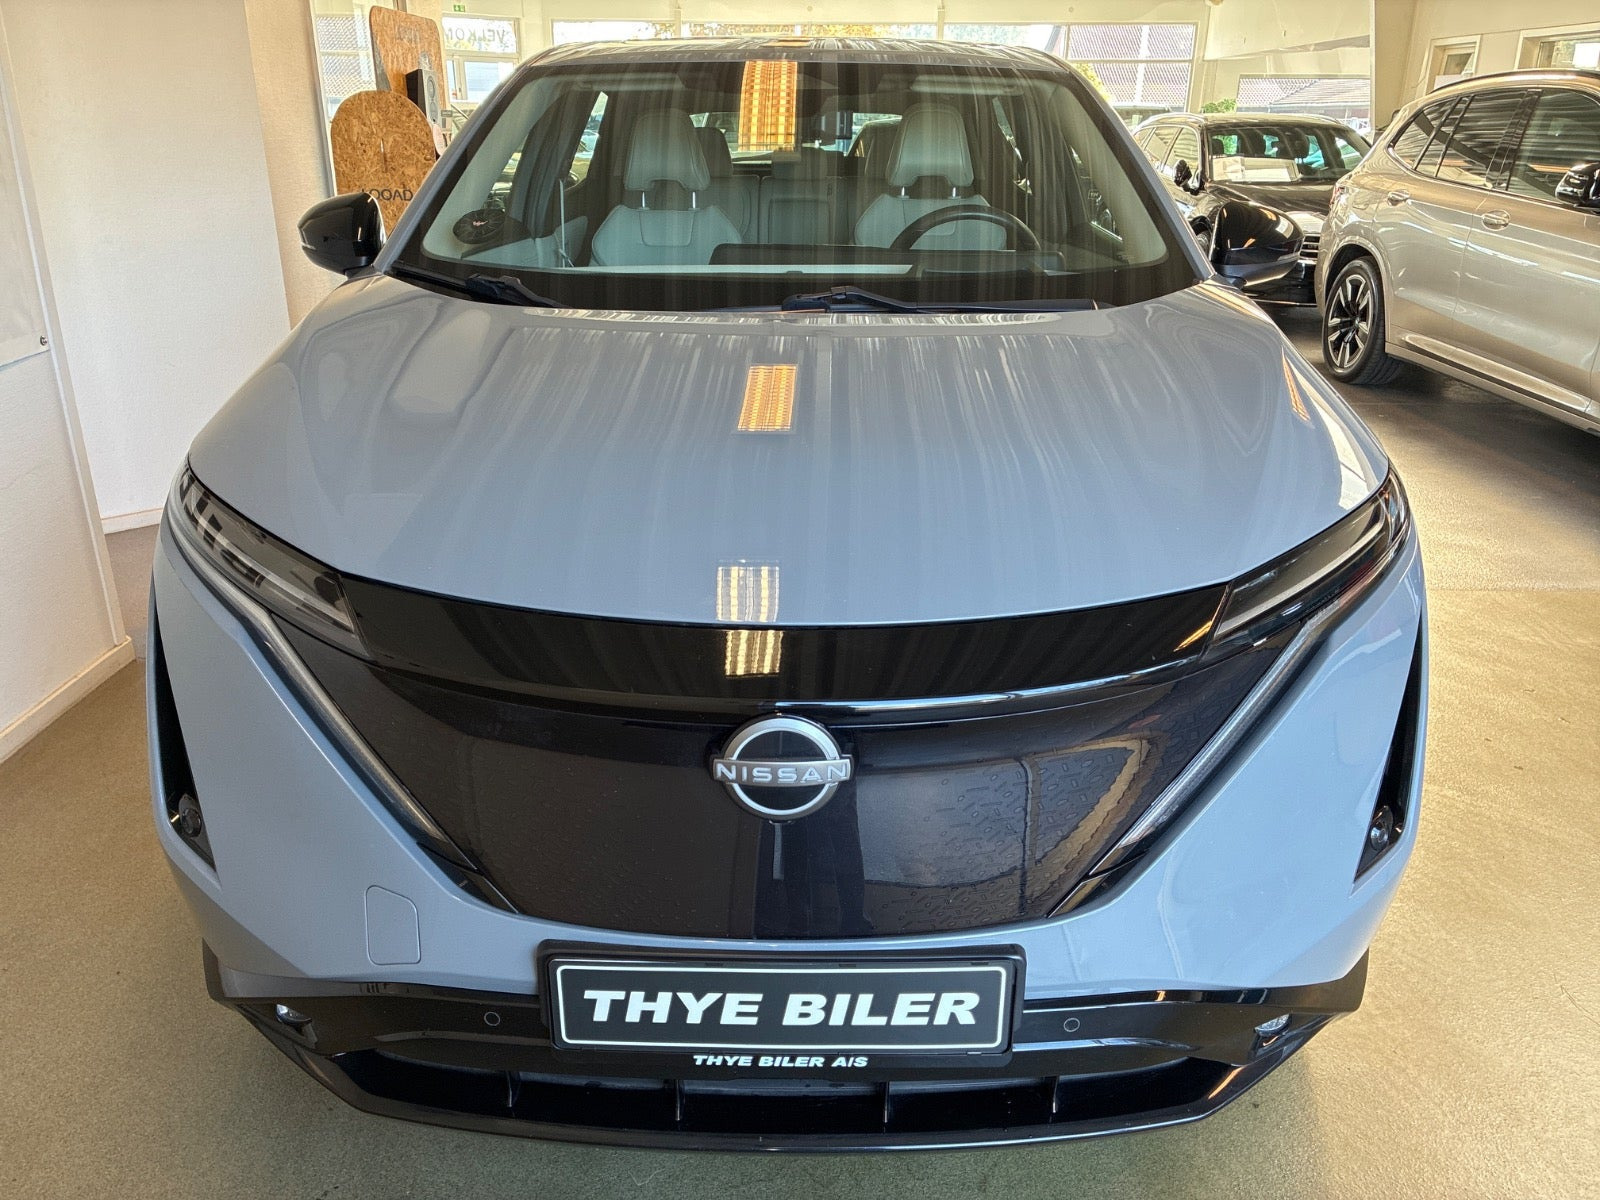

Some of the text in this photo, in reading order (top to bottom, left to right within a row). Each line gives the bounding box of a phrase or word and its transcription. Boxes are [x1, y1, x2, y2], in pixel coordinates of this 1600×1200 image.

[716, 763, 848, 784] NISSAN
[584, 990, 980, 1026] THYE BILER
[693, 1055, 869, 1068] THYE BILER A/S
